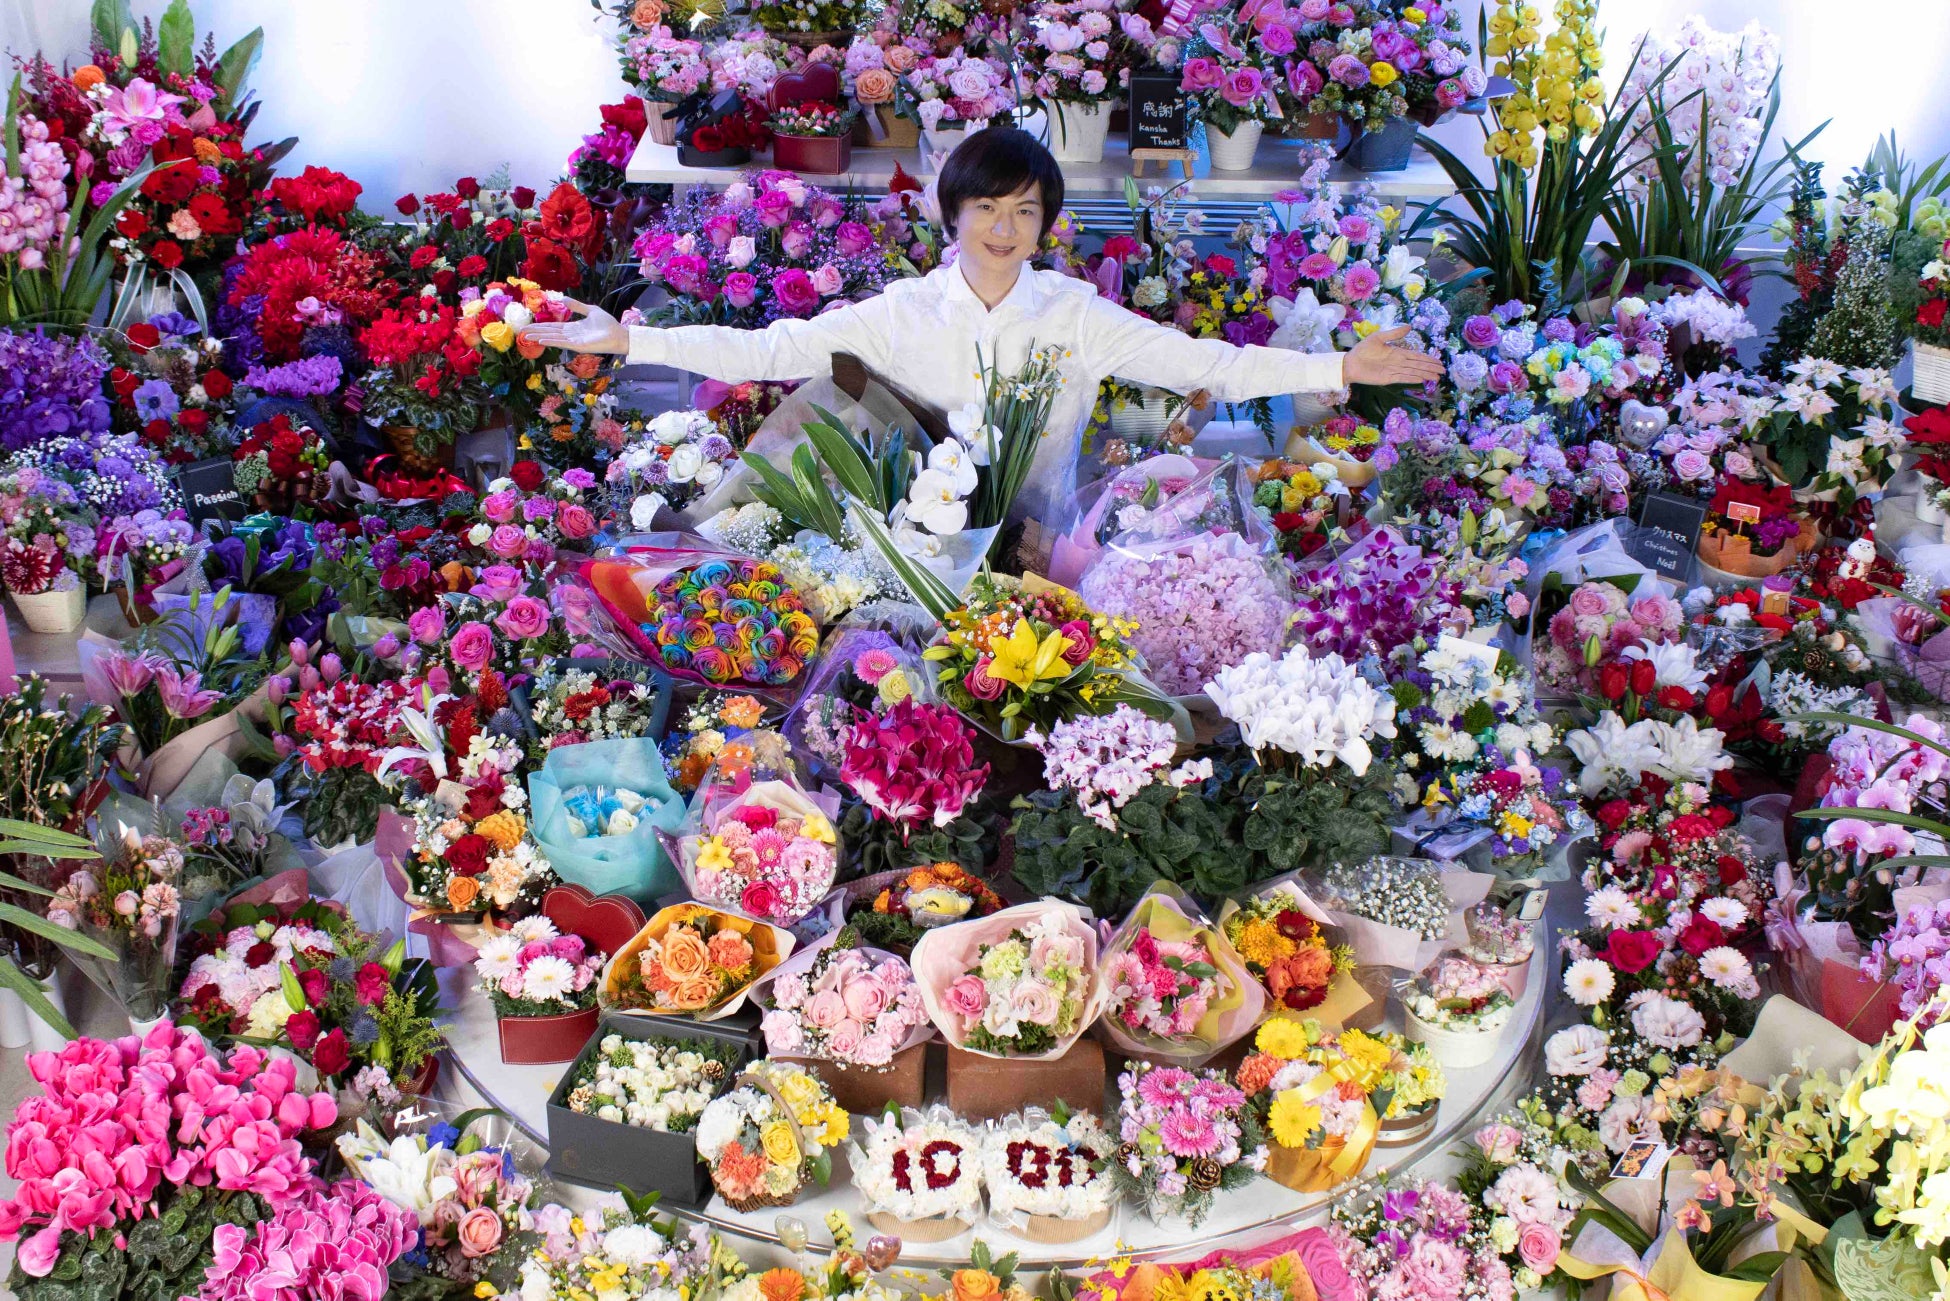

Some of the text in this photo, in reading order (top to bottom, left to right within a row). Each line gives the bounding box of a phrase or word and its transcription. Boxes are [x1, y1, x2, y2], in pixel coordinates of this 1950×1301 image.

[1143, 101, 1173, 118] 感謝
[1150, 137, 1180, 146] Thanks
[194, 490, 238, 507] Passion
[1652, 526, 1687, 543] クリスマス
